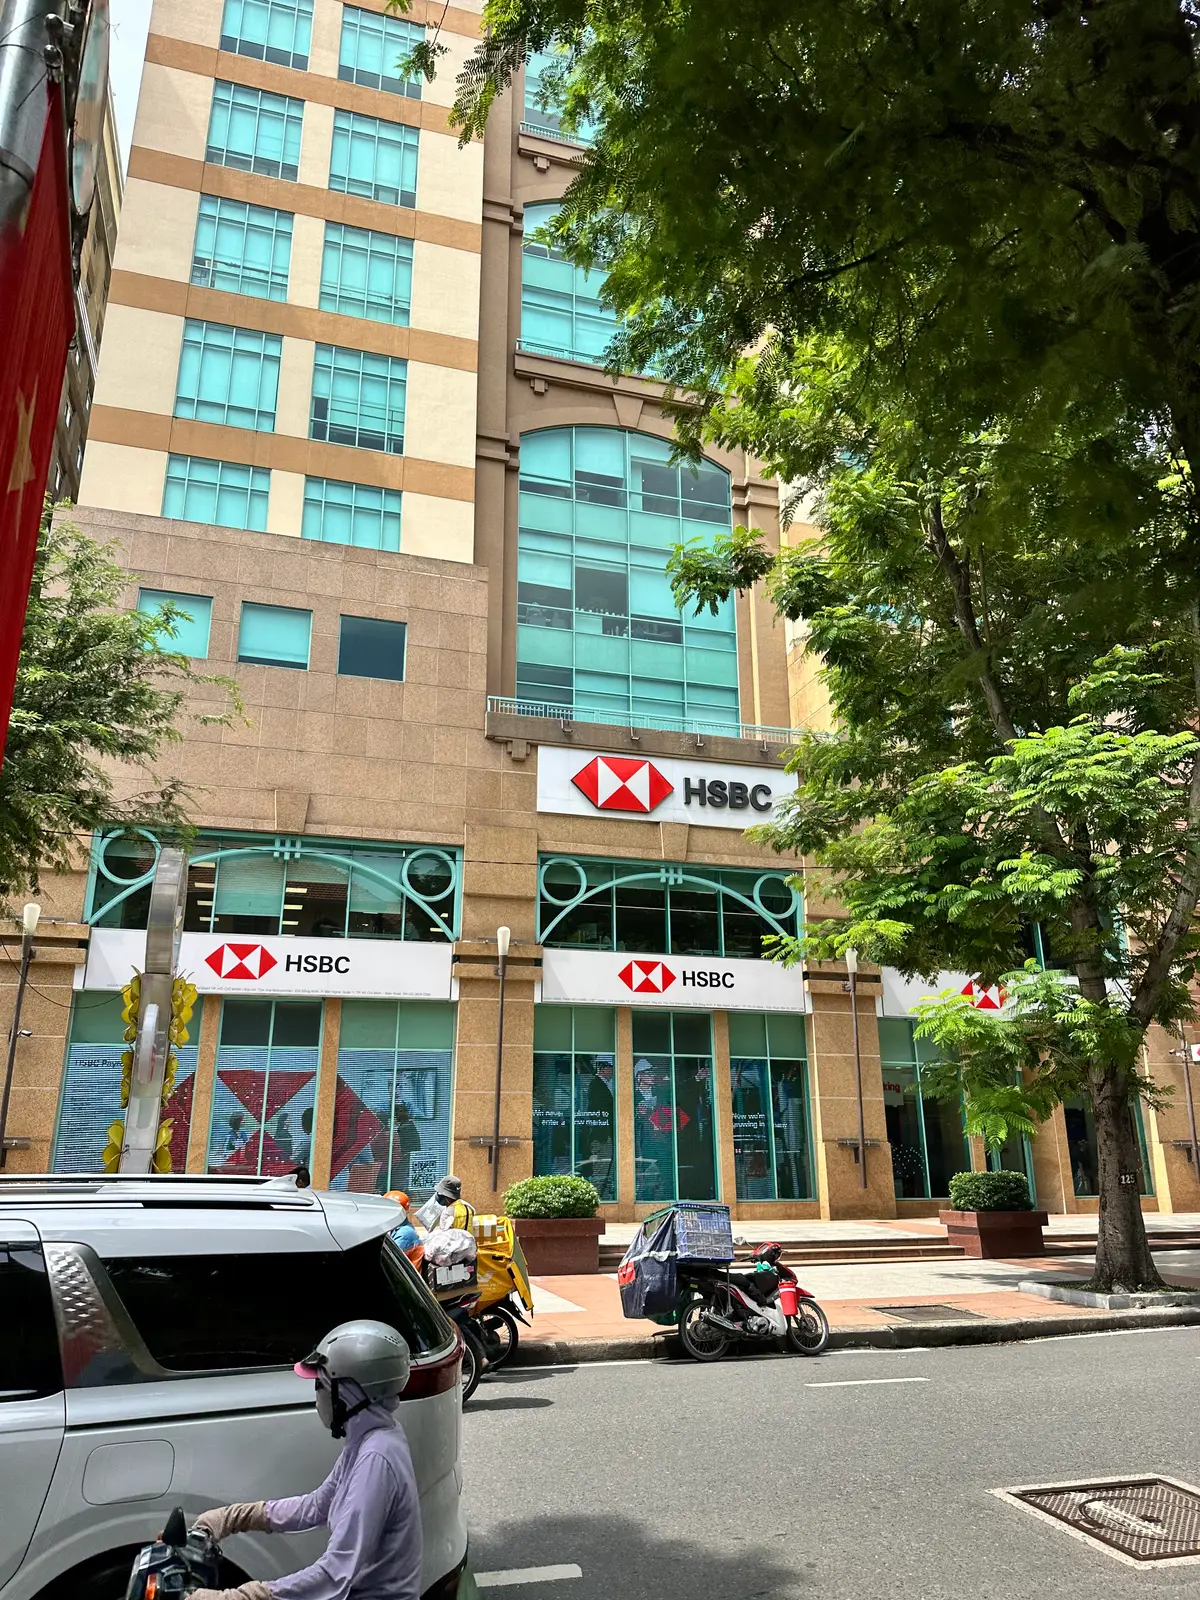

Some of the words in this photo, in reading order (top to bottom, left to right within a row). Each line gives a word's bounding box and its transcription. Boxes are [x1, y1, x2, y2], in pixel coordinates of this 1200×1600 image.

[683, 777, 773, 812] HSBC
[285, 954, 351, 974] HSBC
[682, 970, 735, 989] HSBC
[1120, 1174, 1136, 1185] 125
